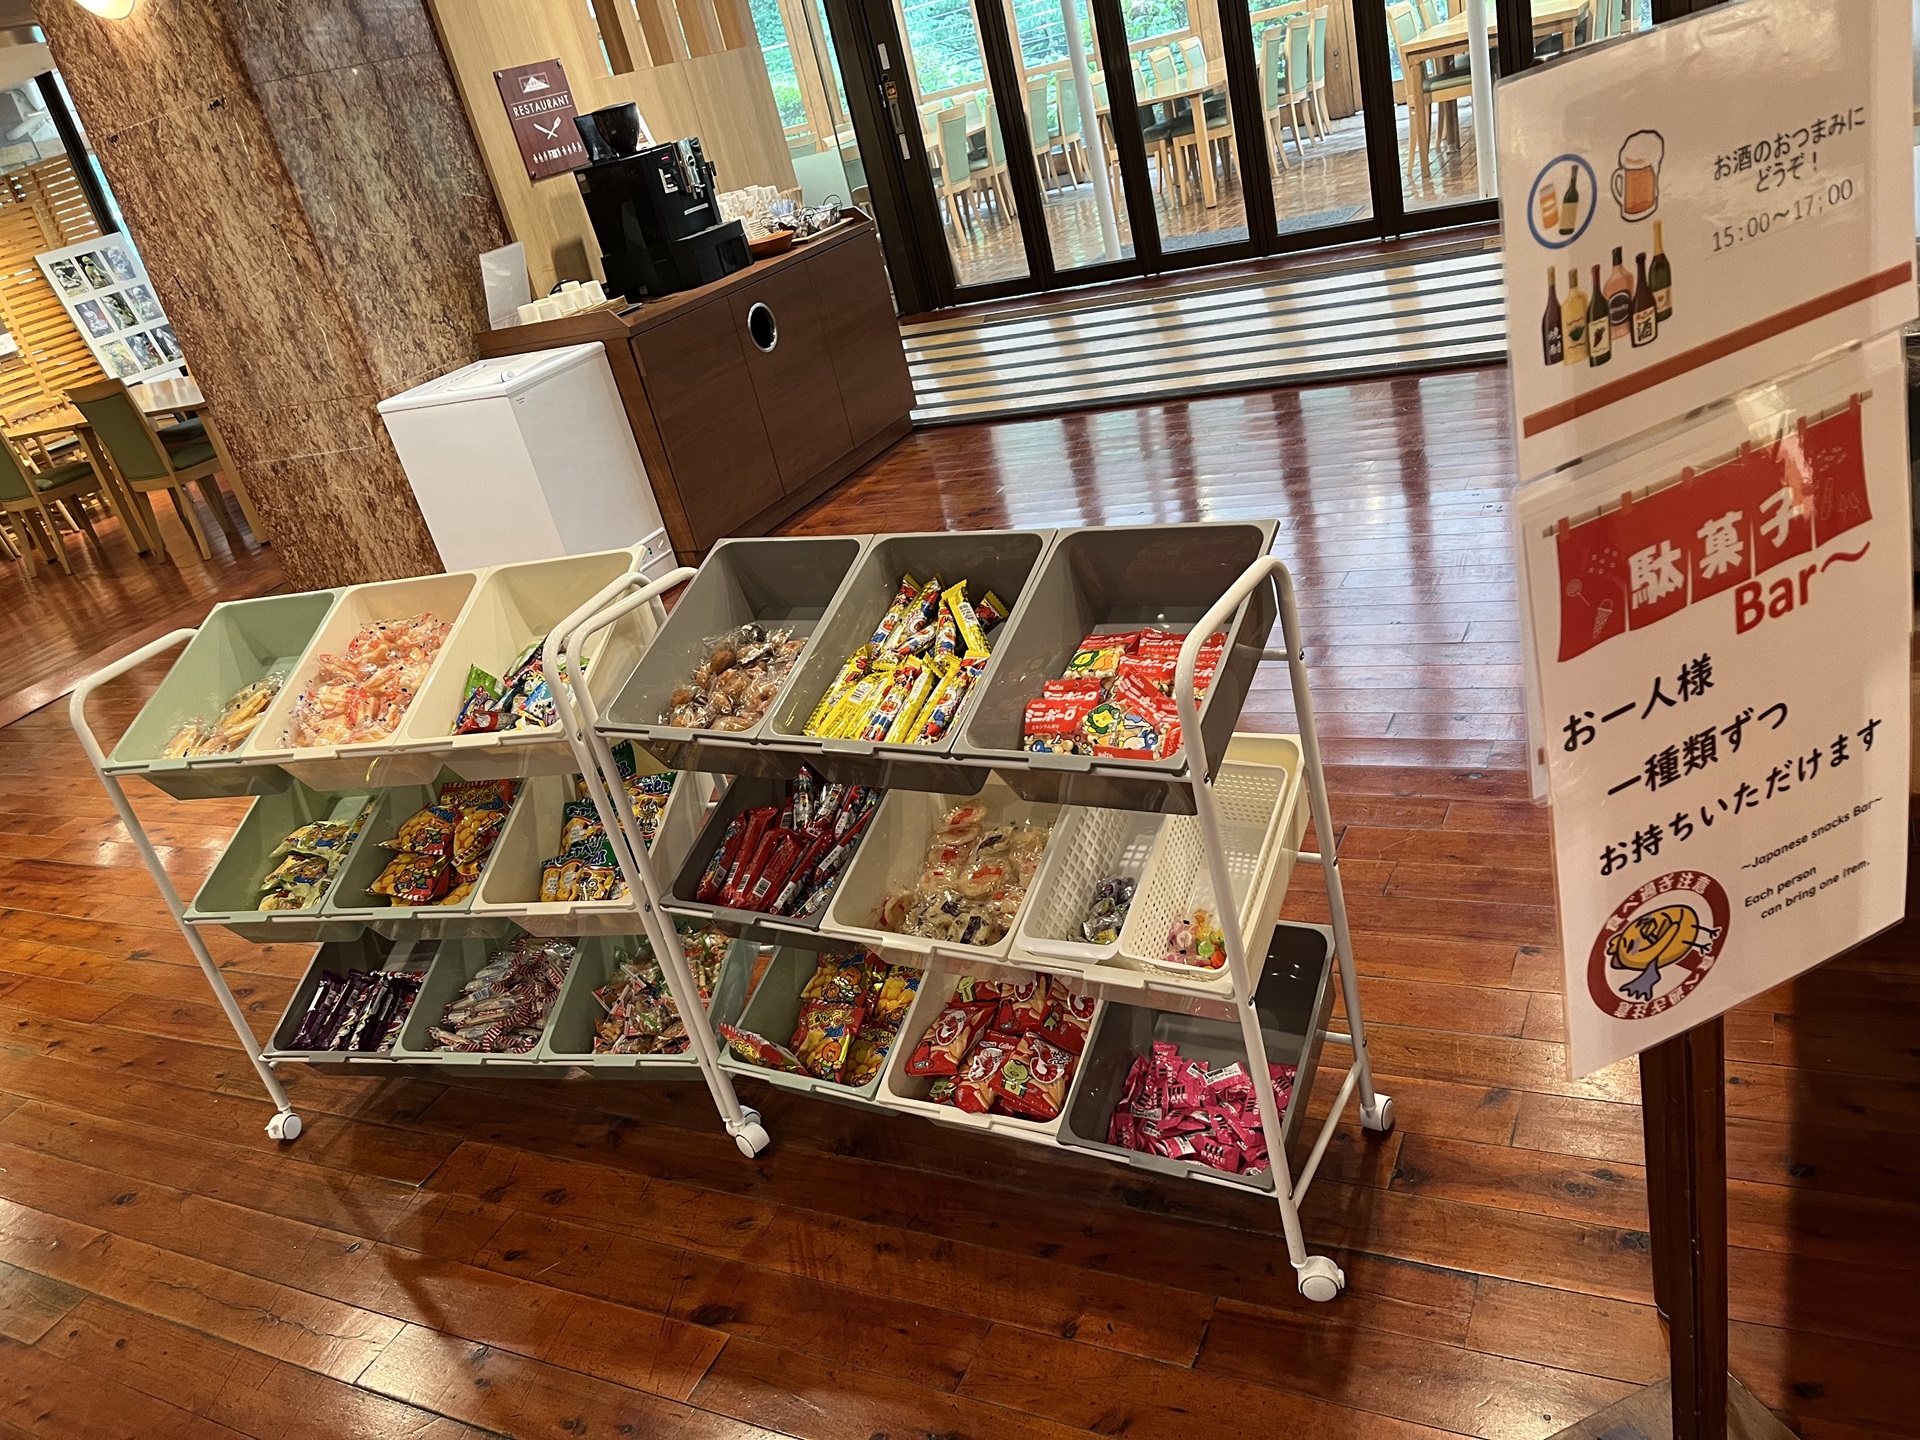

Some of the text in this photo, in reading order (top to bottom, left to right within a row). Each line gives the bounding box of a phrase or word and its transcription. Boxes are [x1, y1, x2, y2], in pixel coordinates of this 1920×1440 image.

[513, 95, 569, 118] RESTAURANT
[1713, 107, 1866, 181] お酒のおつまみに
[1628, 486, 1804, 610] 駄菓子
[1025, 708, 1076, 723] ミニボーロ
[1563, 653, 1714, 752] お一人様
[1607, 702, 1789, 796] 一種類ずつ
[1600, 718, 1882, 876] お持ちいただけます
[1811, 813, 1850, 838] snacks
[1744, 866, 1817, 907] Each person
[1760, 860, 1870, 919] can bring one item.
[1170, 1092, 1189, 1102] AKE
[1200, 1149, 1227, 1165] BAKE
